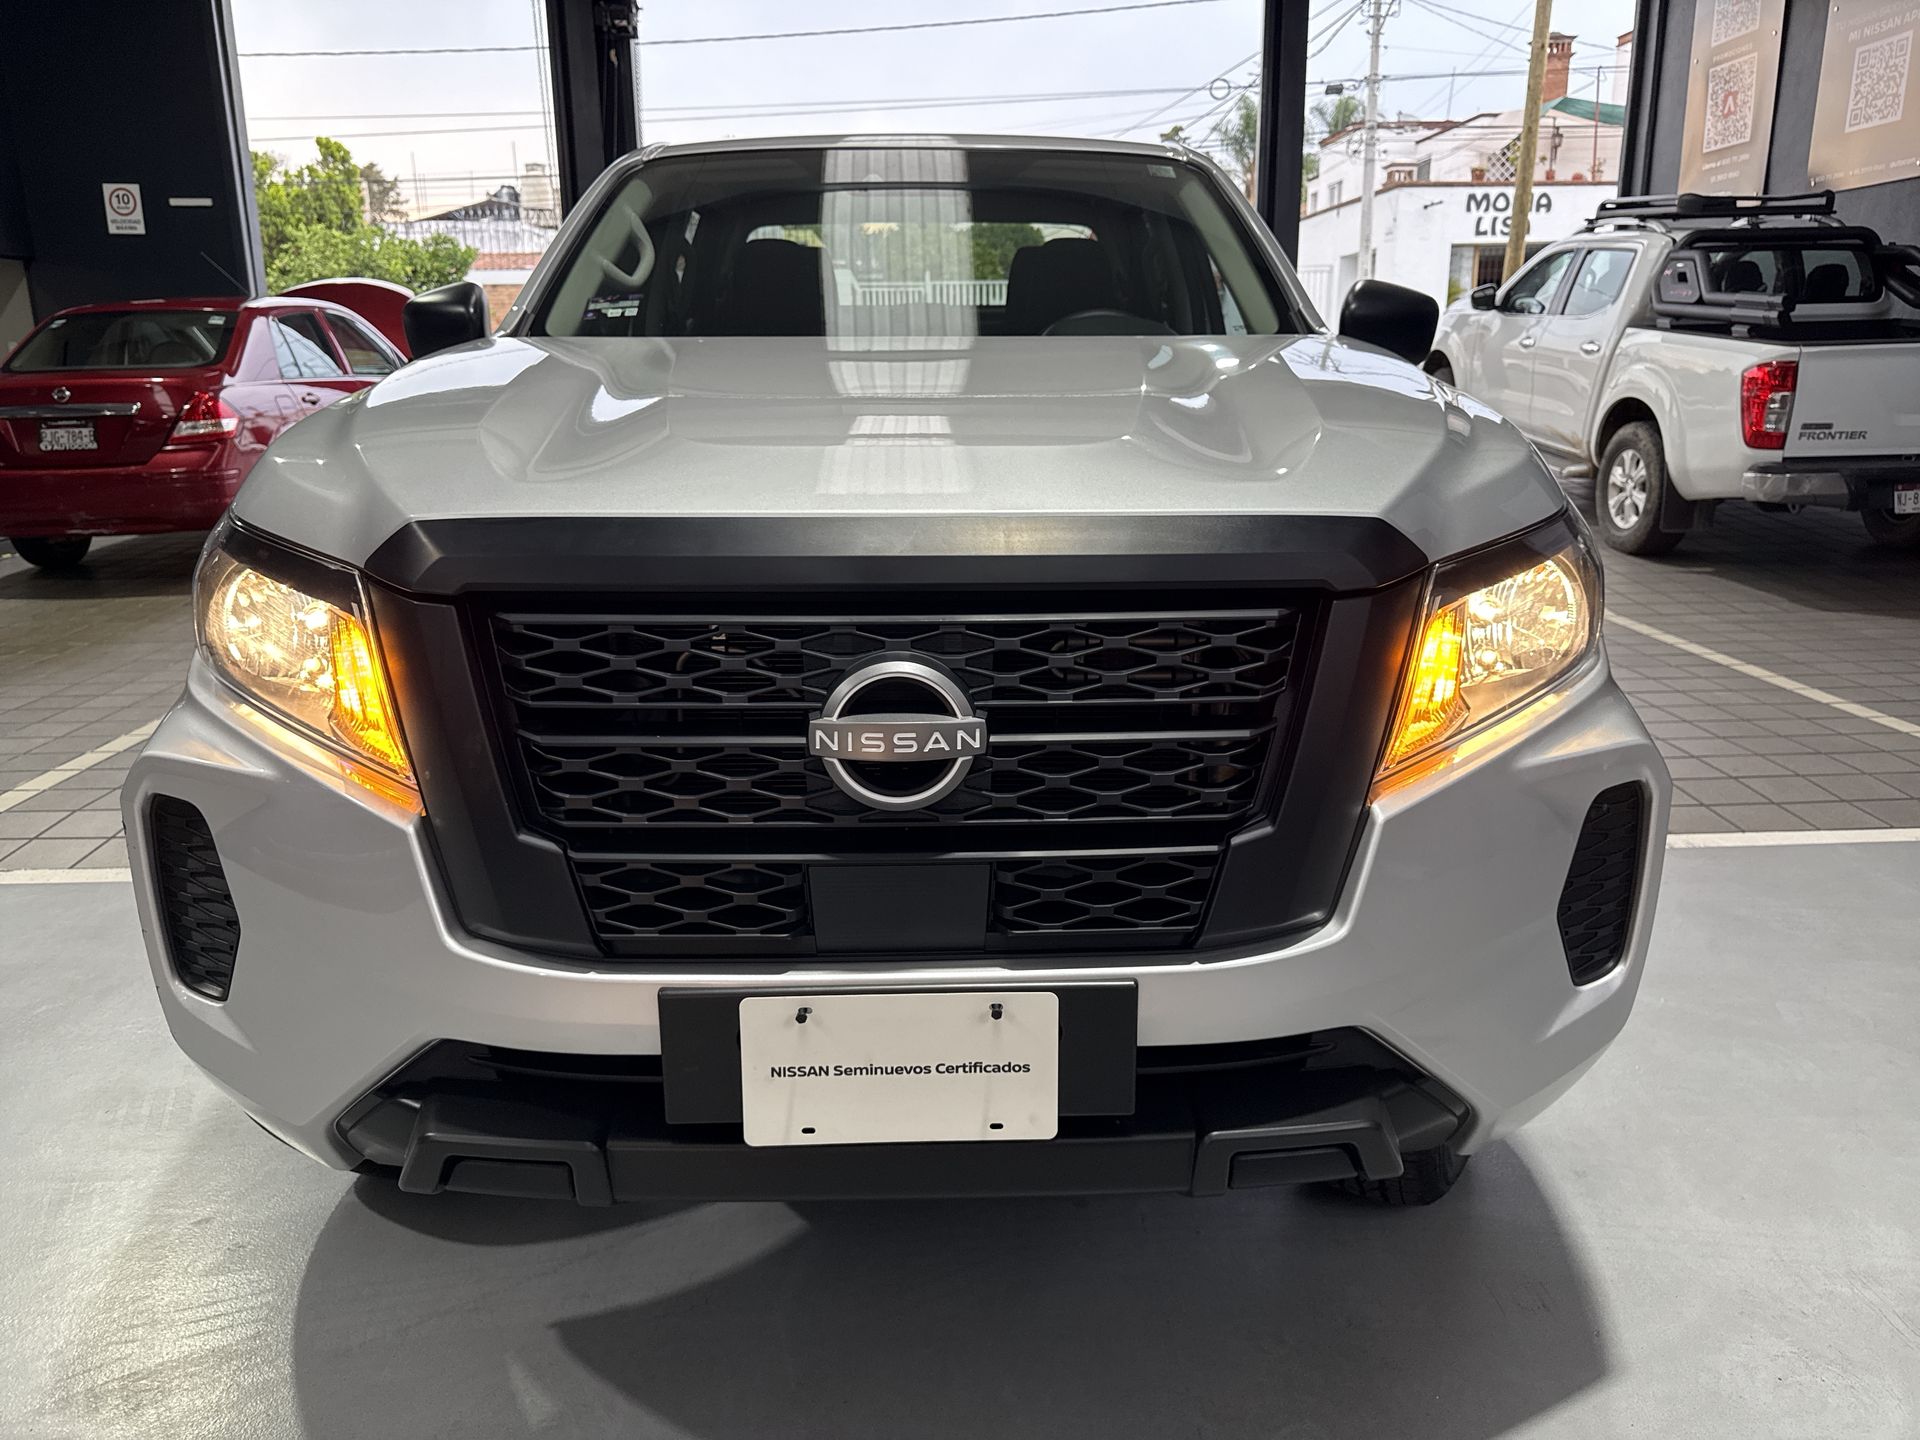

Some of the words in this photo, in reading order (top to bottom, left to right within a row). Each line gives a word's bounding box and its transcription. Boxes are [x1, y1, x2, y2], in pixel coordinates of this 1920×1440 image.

[1863, 15, 1902, 37] NISSAN
[114, 193, 130, 205] 10
[1466, 192, 1552, 213] MOA
[1798, 431, 1868, 440] FRONTIER
[815, 728, 981, 753] NISSAN
[771, 1065, 830, 1078] NISSAN
[833, 1063, 932, 1077] Seminuevos
[935, 1061, 1031, 1074] Certificados
